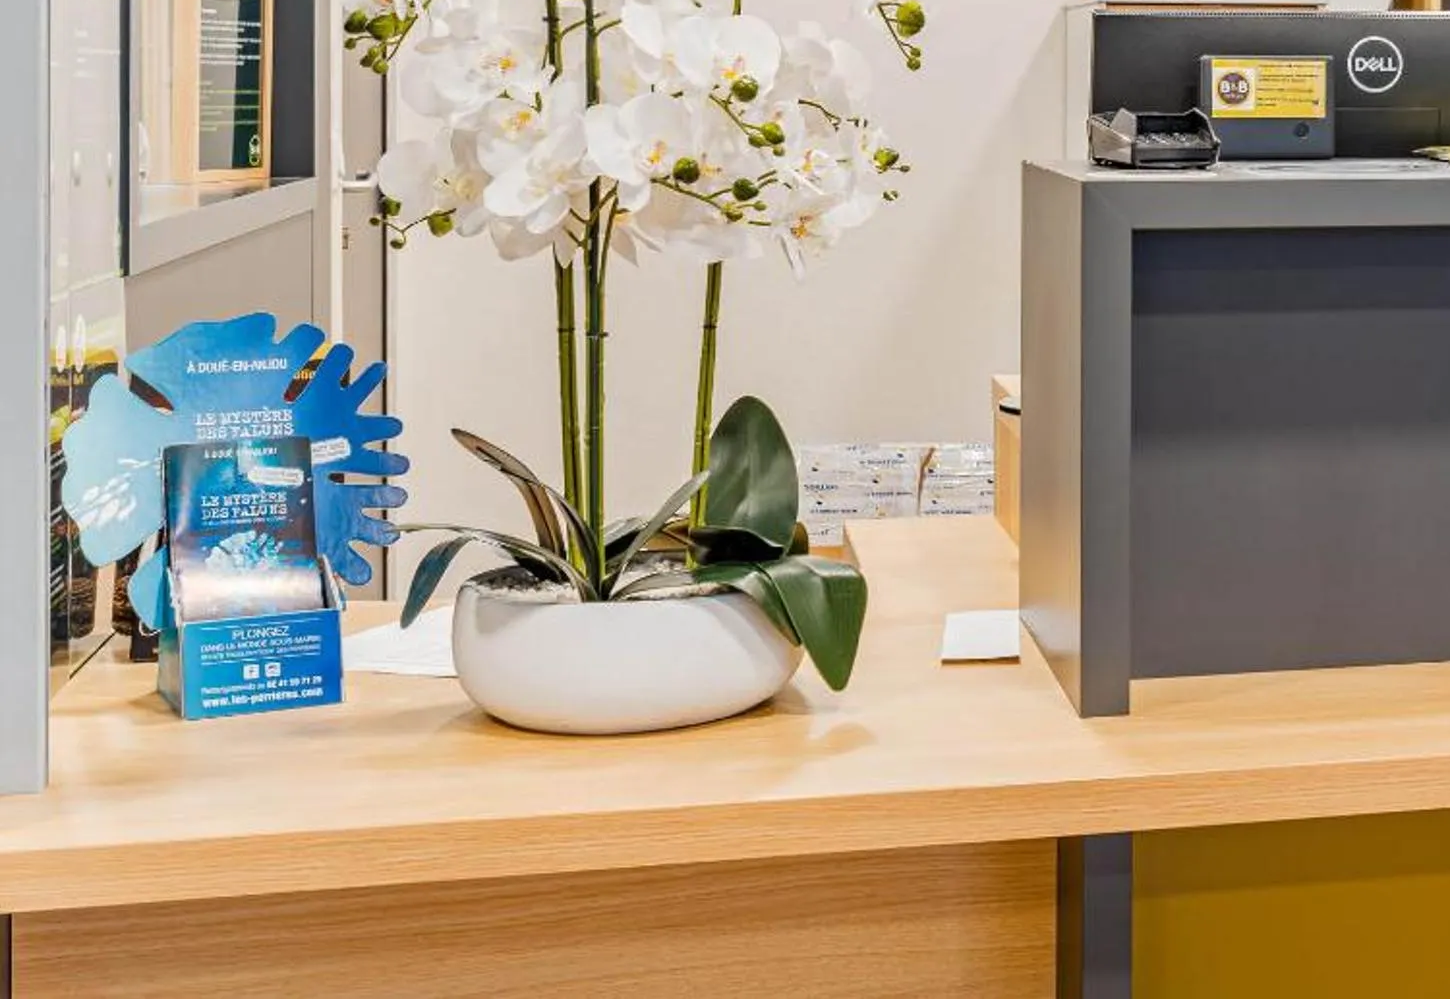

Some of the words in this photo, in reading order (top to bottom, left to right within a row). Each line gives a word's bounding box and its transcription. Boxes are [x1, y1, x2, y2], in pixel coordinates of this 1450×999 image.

[1355, 57, 1397, 72] DELL
[195, 412, 216, 426] LE
[220, 405, 293, 425] MYSTÈRE
[197, 426, 228, 440] DES
[231, 423, 294, 439] FALUNS
[201, 495, 220, 506] LE
[223, 489, 287, 506] MYSTÈRE
[201, 507, 229, 520] DES
[231, 503, 288, 518] FALUNS
[231, 625, 290, 640] PLONGEZ
